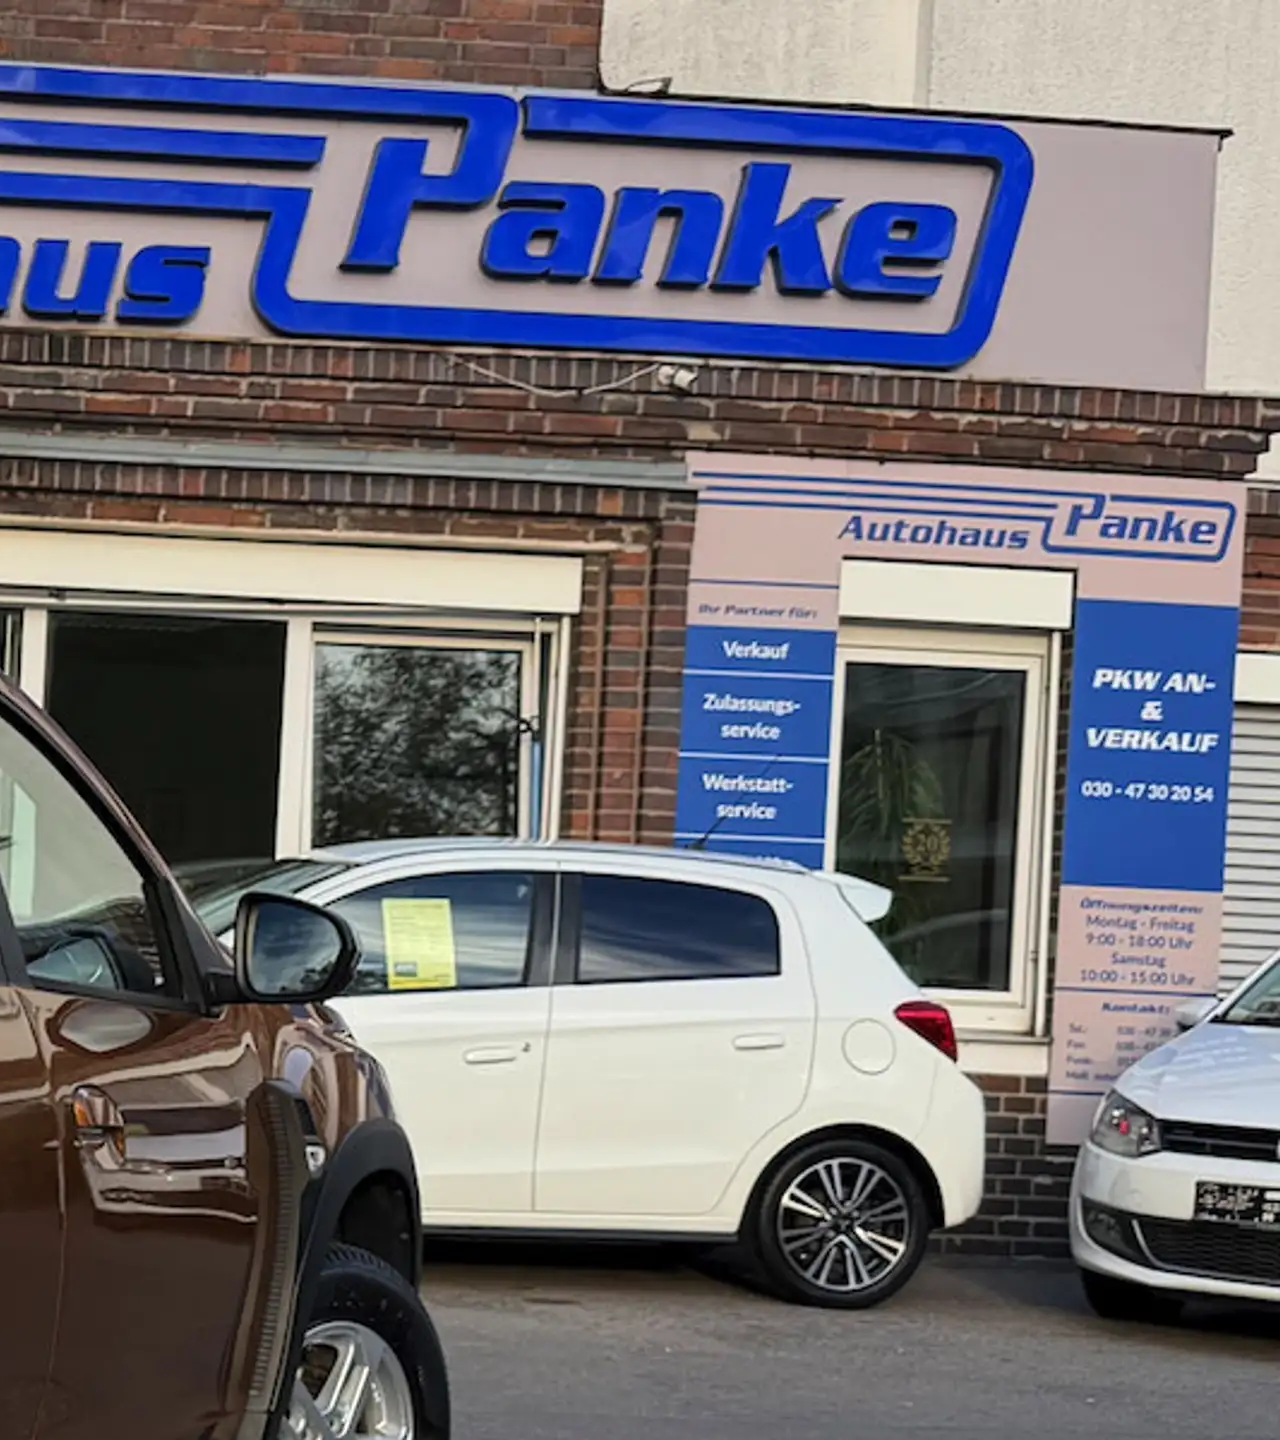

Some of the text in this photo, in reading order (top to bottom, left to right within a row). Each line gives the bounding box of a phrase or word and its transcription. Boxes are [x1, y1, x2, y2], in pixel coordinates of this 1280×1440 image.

[338, 95, 959, 302] Panke
[838, 496, 1219, 550] Autohaus Panke
[724, 604, 786, 617] Partner
[723, 640, 790, 660] Verkauf
[1092, 668, 1217, 694] PKW AN-
[702, 692, 801, 716] Zulassungs-
[1140, 700, 1164, 721] &
[721, 722, 781, 739] service
[1086, 727, 1219, 754] VERKAUF
[702, 773, 794, 793] Werkstatt-
[1081, 780, 1113, 797] 030
[1124, 783, 1146, 799] 47
[1148, 784, 1169, 800] 30
[1170, 785, 1191, 801] 20
[1193, 785, 1214, 803] 54
[717, 802, 778, 820] service
[1085, 914, 1137, 930] Montag
[1149, 917, 1195, 934] Freitag
[1169, 936, 1194, 950] Uhr
[1111, 952, 1168, 968] Samstag
[1171, 973, 1196, 986] Uhr
